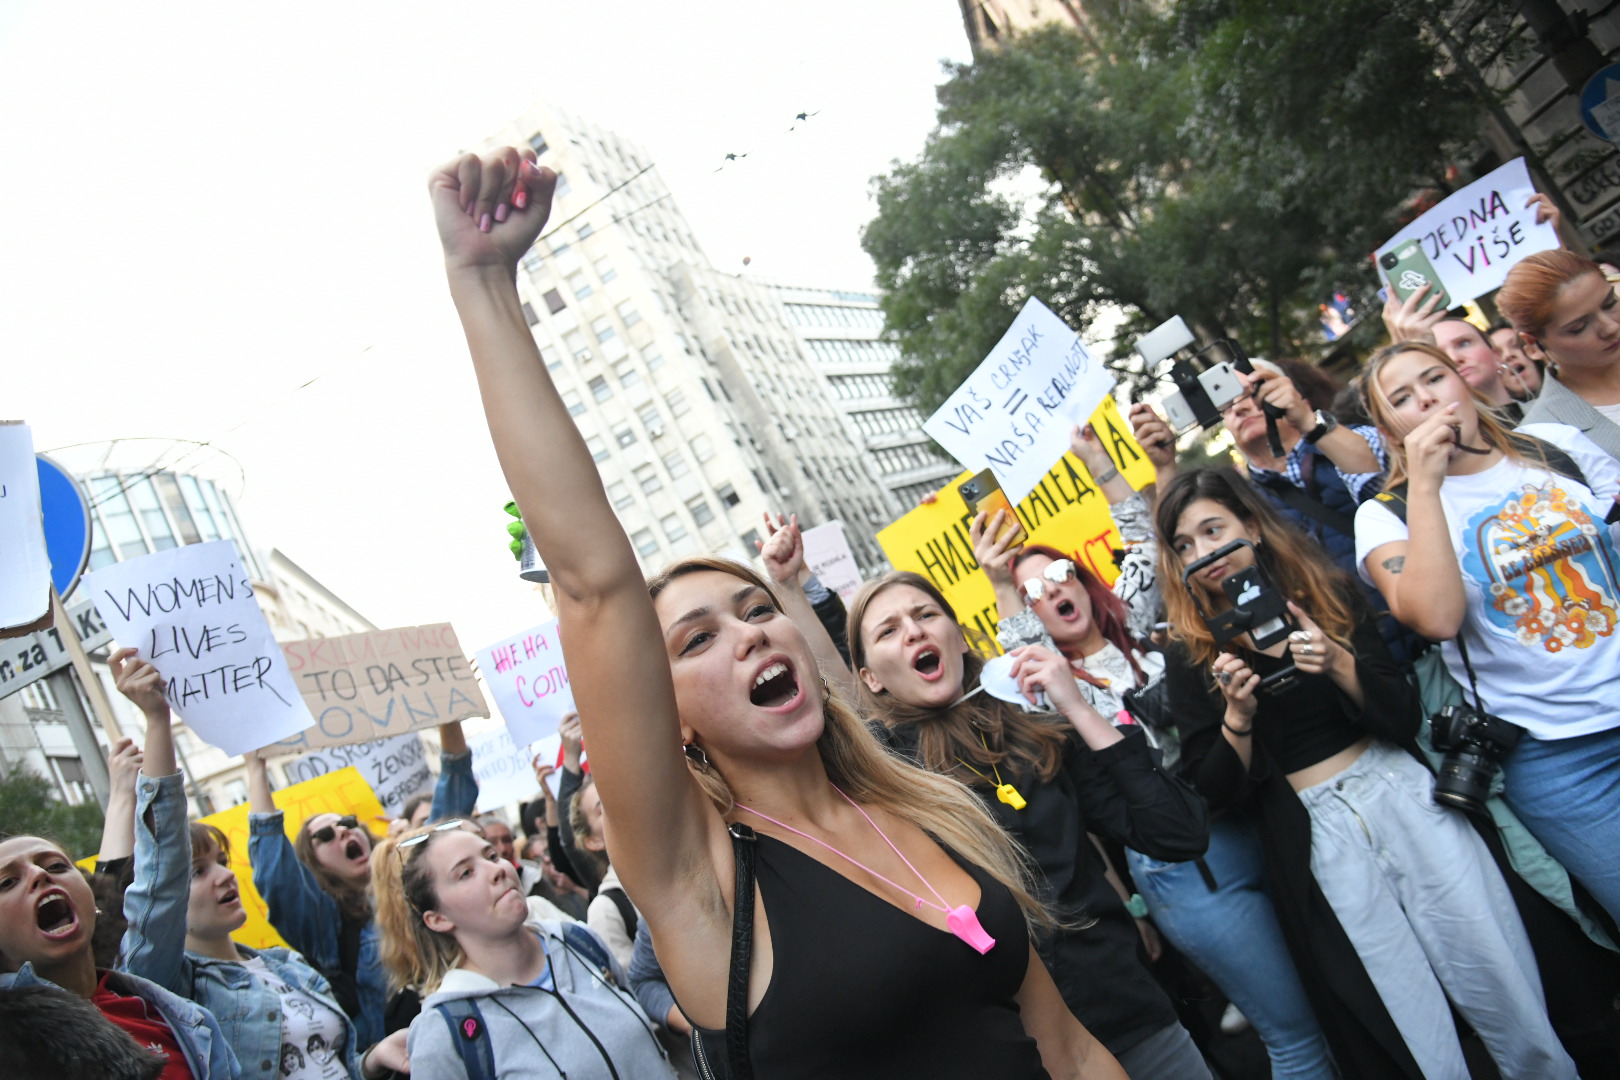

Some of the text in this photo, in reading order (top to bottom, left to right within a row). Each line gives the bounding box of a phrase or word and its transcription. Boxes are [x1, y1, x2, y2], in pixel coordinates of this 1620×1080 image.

[1424, 190, 1510, 260] JEDNA
[944, 387, 993, 435] VAŠ
[984, 411, 1046, 478] NAŠA
[18, 643, 48, 672] za
[150, 623, 247, 660] LIVES
[285, 625, 458, 672] SKLUZIVNO
[166, 655, 293, 711] MATTER
[302, 654, 474, 702] TO DA STE
